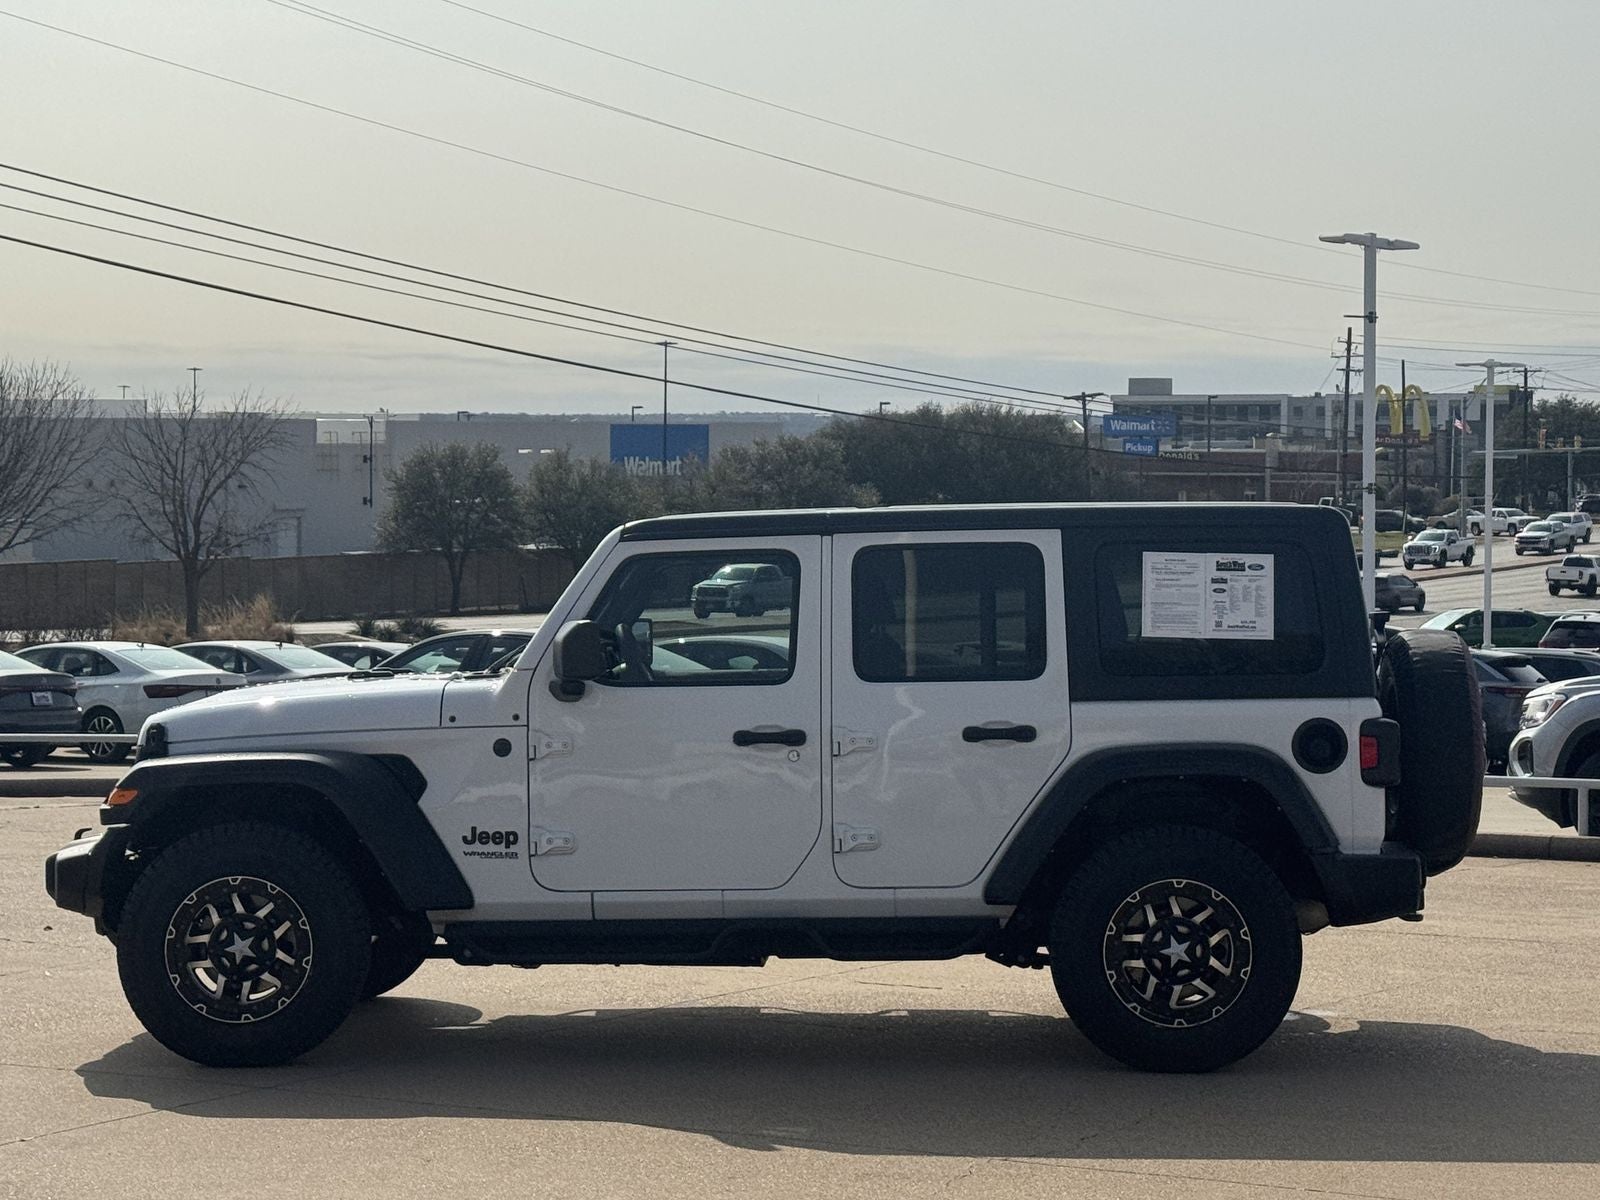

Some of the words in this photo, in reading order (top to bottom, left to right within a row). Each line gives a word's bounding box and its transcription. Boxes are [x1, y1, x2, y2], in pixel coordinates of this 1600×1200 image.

[1110, 419, 1156, 431] Walmart
[1125, 442, 1153, 453] Pickup
[462, 826, 519, 849] Jeep
